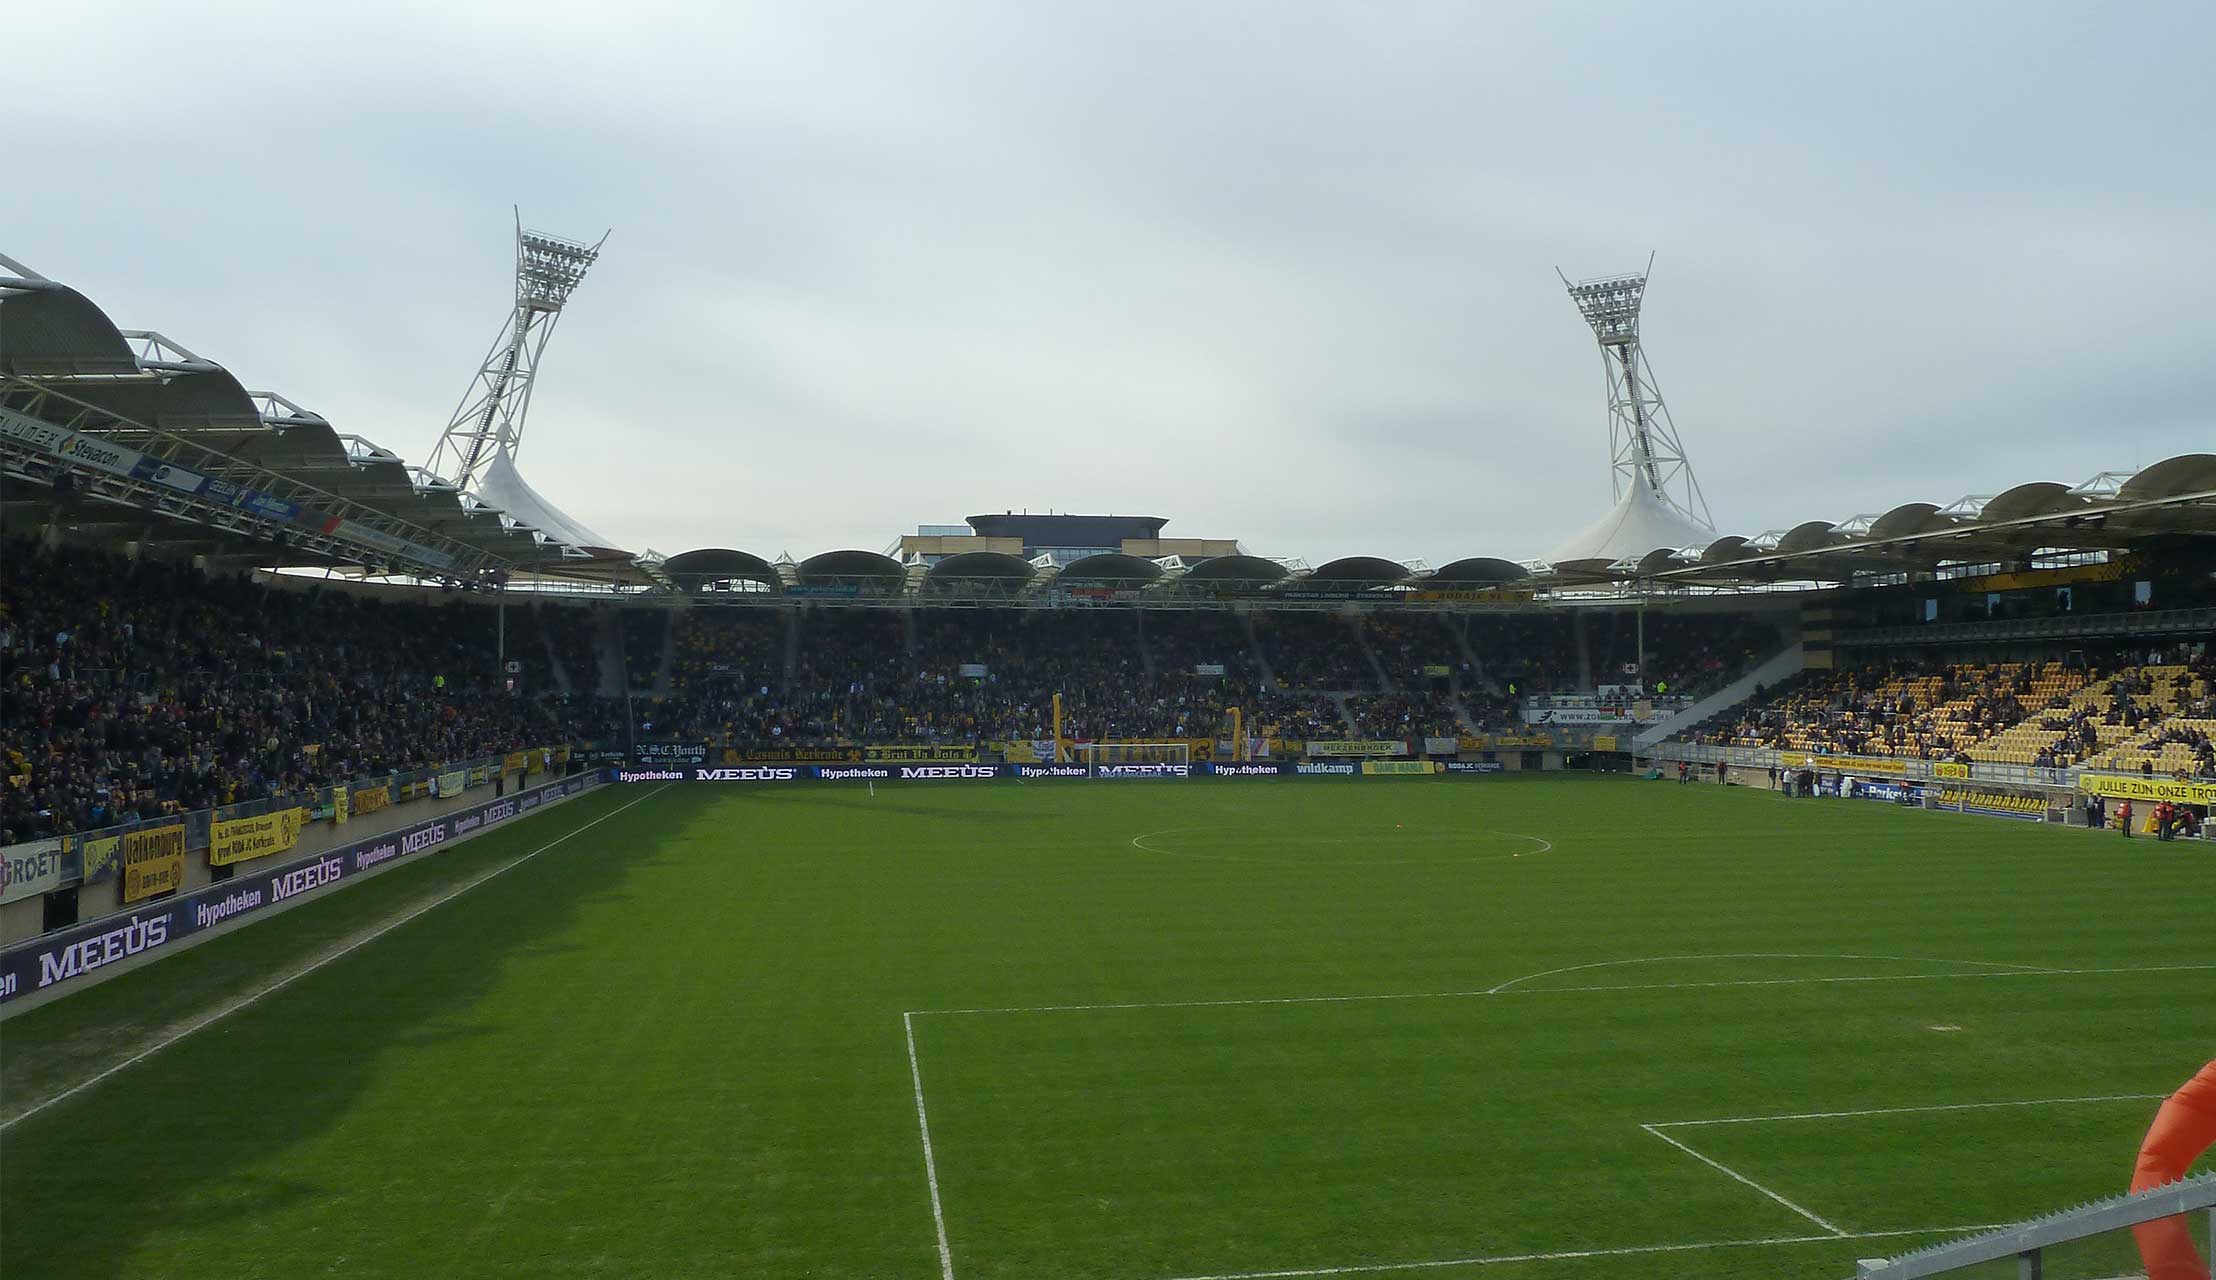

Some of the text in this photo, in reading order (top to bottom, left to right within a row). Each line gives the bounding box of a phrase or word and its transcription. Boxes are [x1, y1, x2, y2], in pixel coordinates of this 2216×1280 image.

[69, 439, 119, 466] Stevacon
[620, 769, 684, 783] Hypotheken
[821, 768, 888, 780] Hypotheken
[1297, 762, 1354, 775] wildkamp
[2098, 780, 2127, 793] JULLIE
[2132, 783, 2153, 796] ZIJN
[2158, 785, 2186, 798] ONZE
[127, 831, 183, 864] Valkenburg
[356, 843, 395, 870] Hypotheken
[197, 888, 263, 928] Hypotheken
